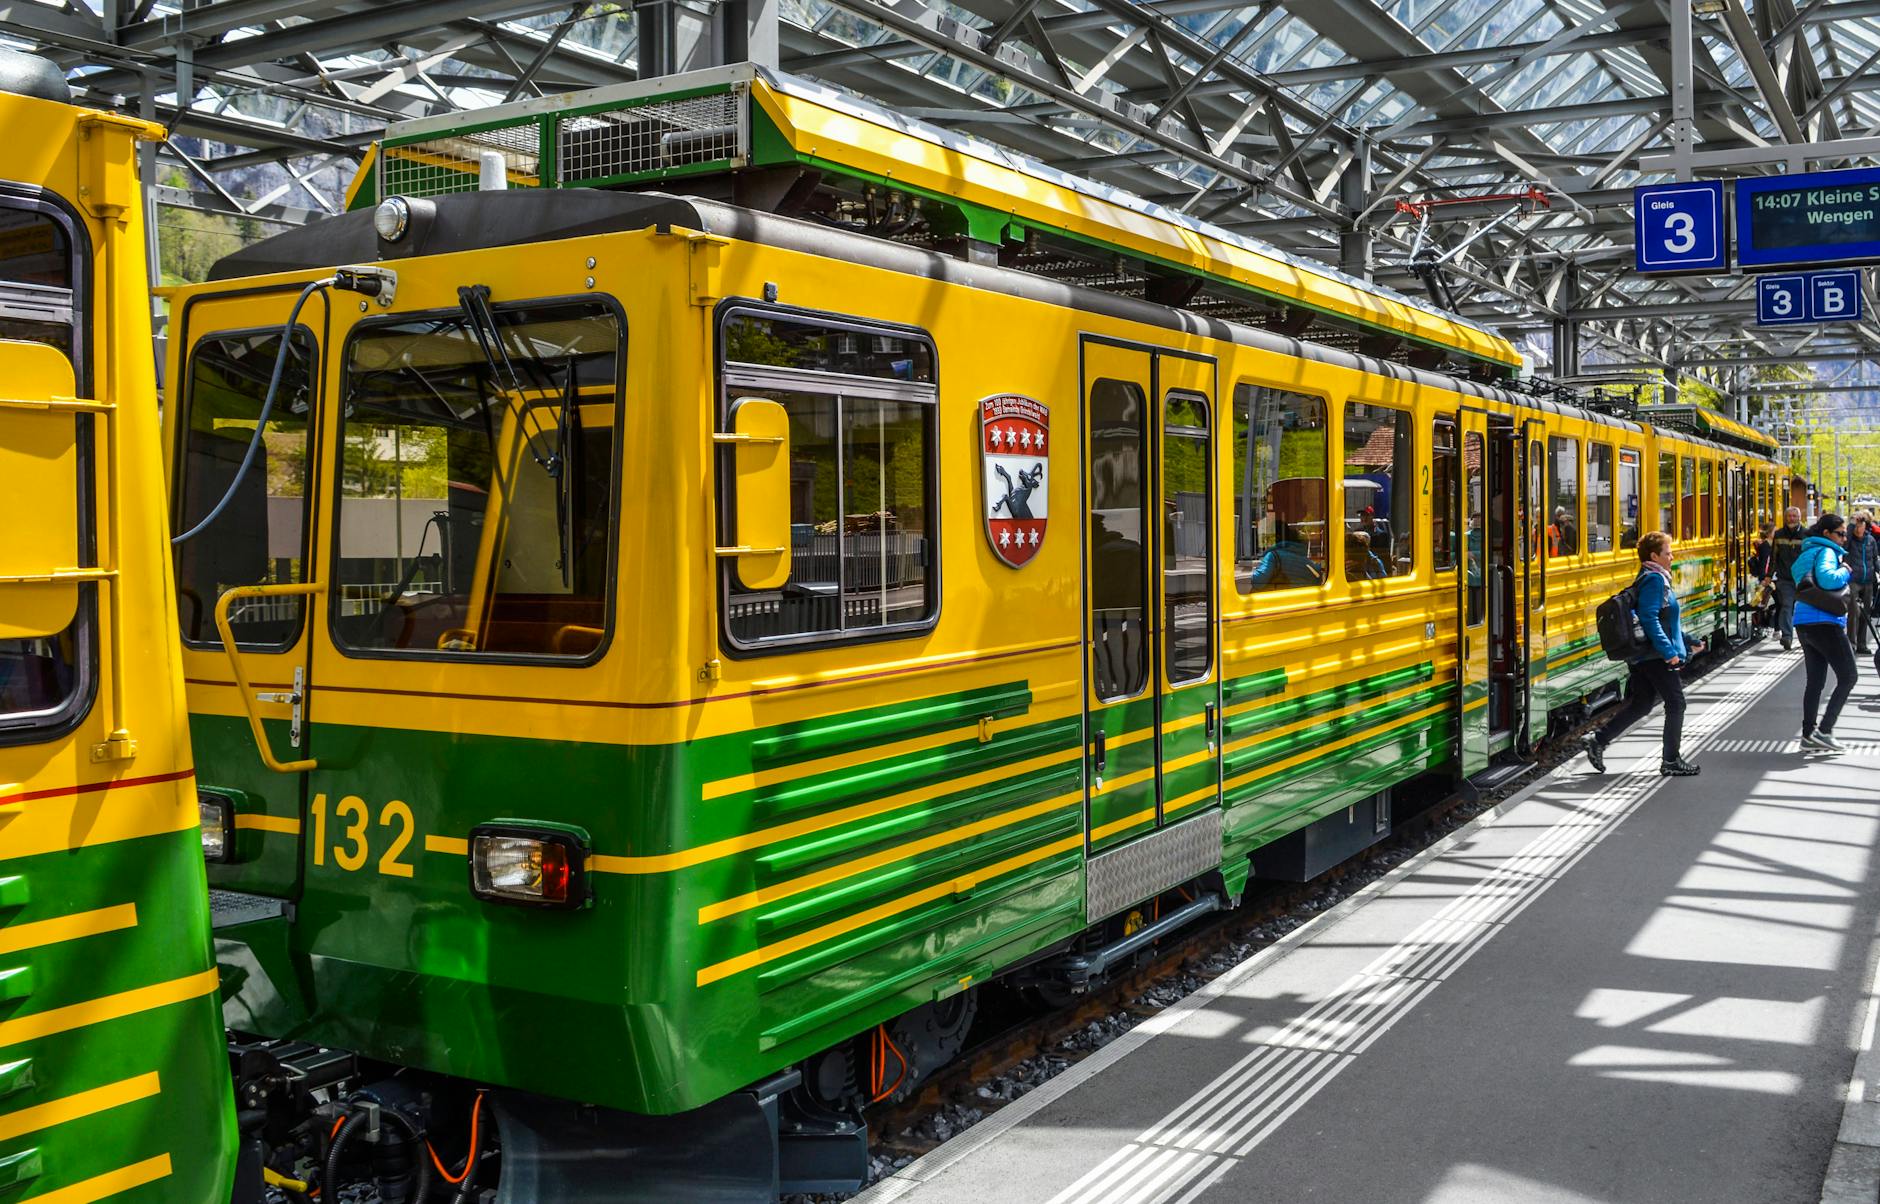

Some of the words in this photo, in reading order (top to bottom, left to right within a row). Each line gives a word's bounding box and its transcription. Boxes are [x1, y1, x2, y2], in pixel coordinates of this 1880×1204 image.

[1651, 201, 1675, 210] Gleis
[1756, 193, 1801, 210] 14:07
[1807, 189, 1863, 206] Kleine
[1807, 210, 1874, 225] Wengen
[1664, 212, 1696, 253] 3
[1772, 290, 1792, 315] 3
[1824, 287, 1845, 313] B
[1422, 465, 1429, 495] 2
[311, 794, 415, 878] 132
